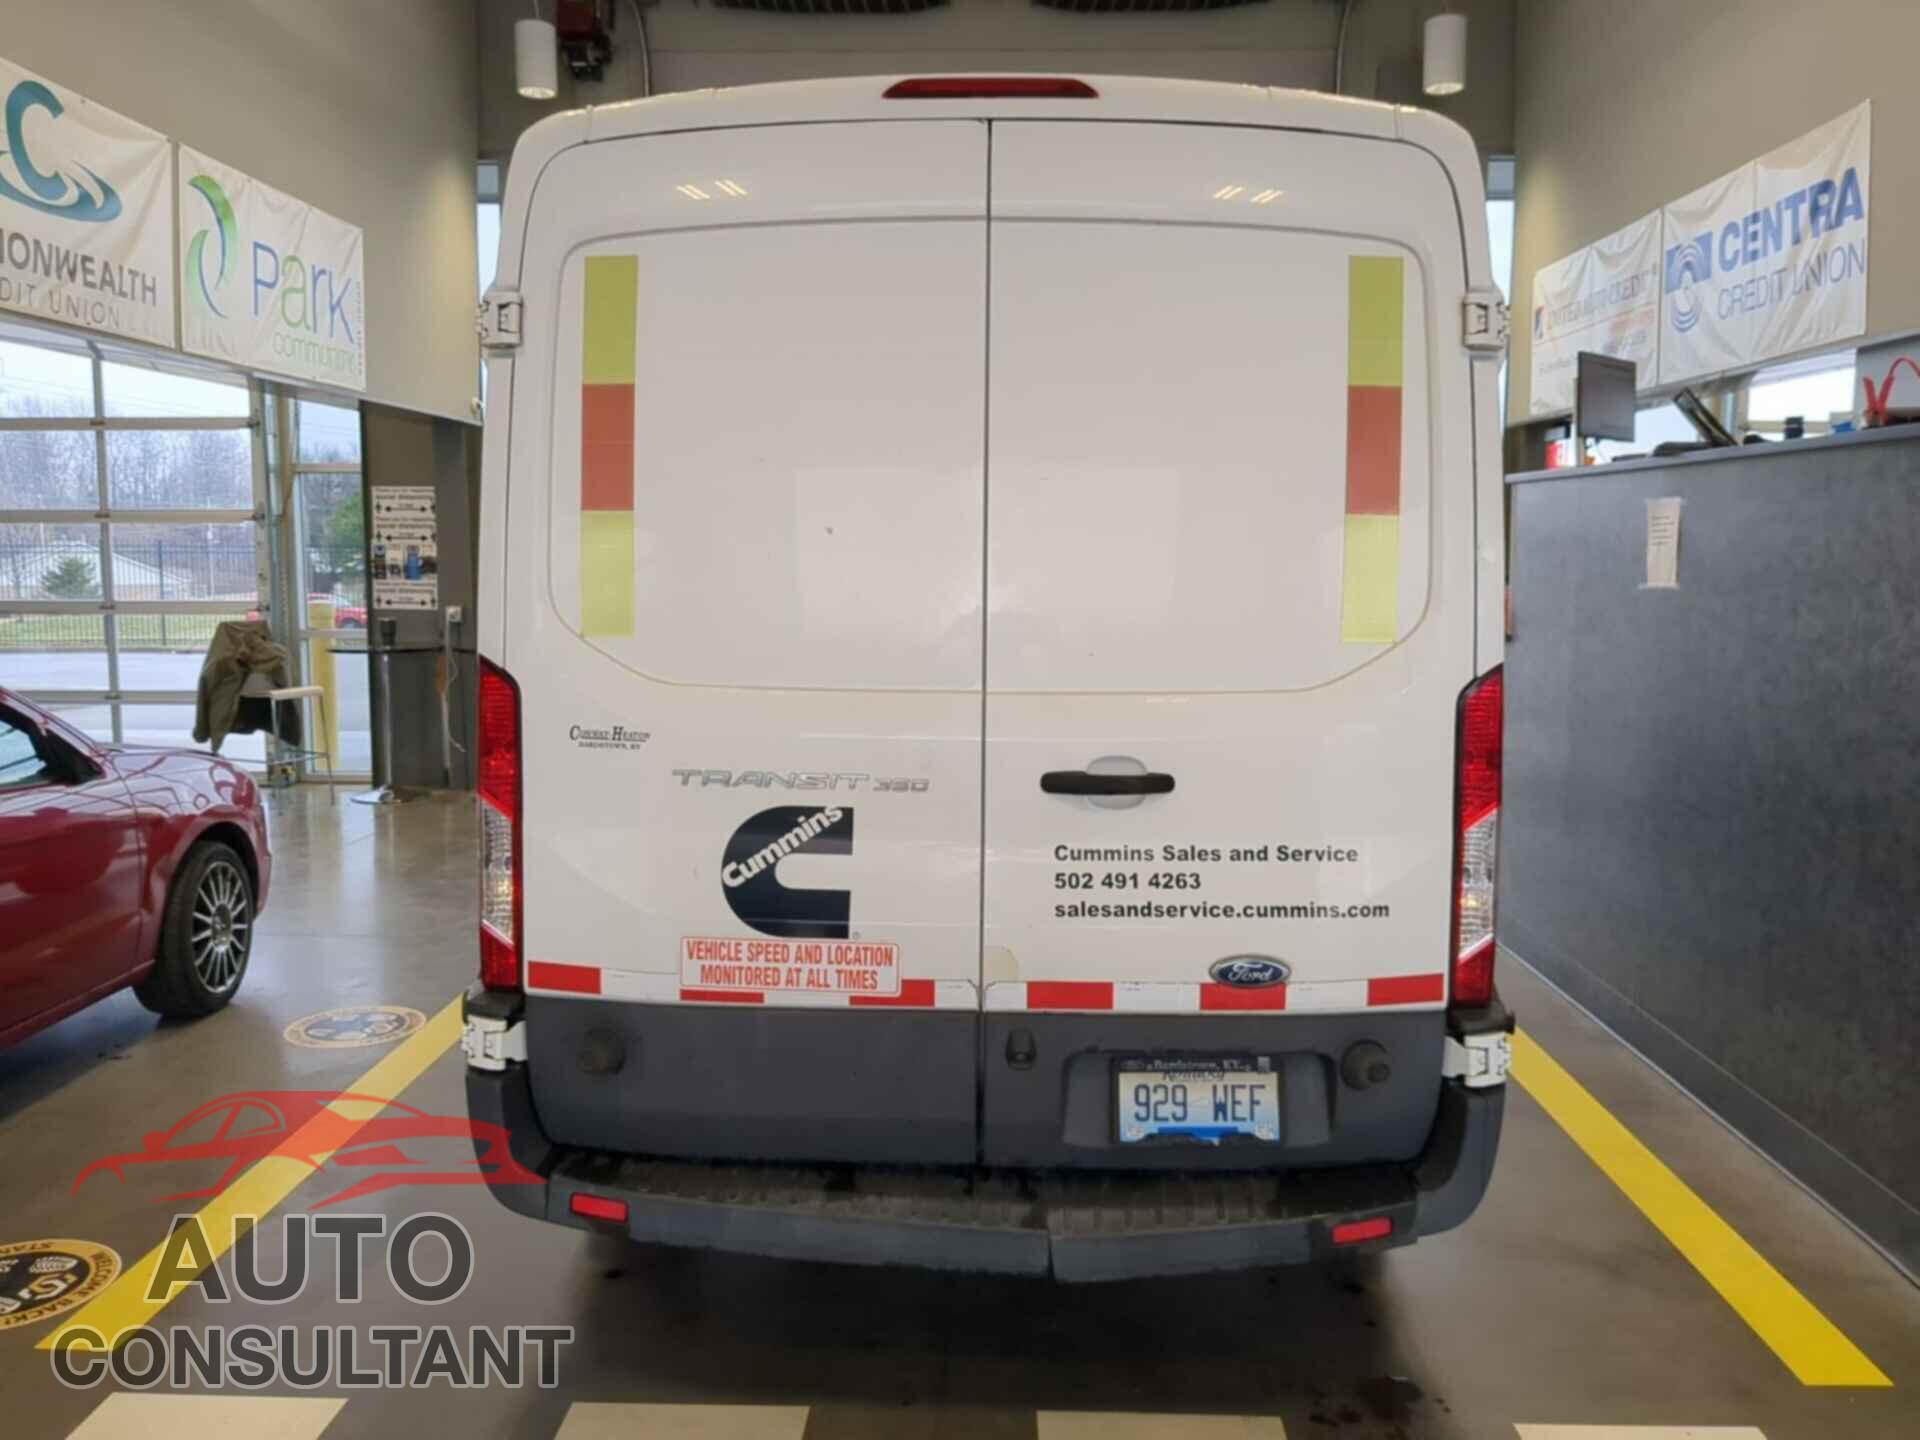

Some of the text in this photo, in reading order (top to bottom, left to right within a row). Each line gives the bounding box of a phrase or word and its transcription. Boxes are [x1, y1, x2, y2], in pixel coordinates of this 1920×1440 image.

[1719, 167, 1864, 272] CENTRA
[0, 228, 157, 307] ONWEALTH
[1718, 268, 1787, 320] CREDIT
[1792, 239, 1865, 296] UNION
[49, 289, 120, 329] UNION
[672, 768, 870, 791] TRANSIT
[722, 804, 844, 888] Cummins
[1054, 845, 1359, 862] Cummins Sales and Service
[1054, 872, 1202, 890] 502 491 4263
[1054, 901, 1390, 918] salesandservice.cummins.com
[686, 941, 893, 968] VEHICLE SPEED AND LOCATION
[700, 964, 878, 990] MONITORED AT ALL TIMES
[1228, 963, 1274, 981] Ford
[1134, 1084, 1266, 1122] 929 WEF
